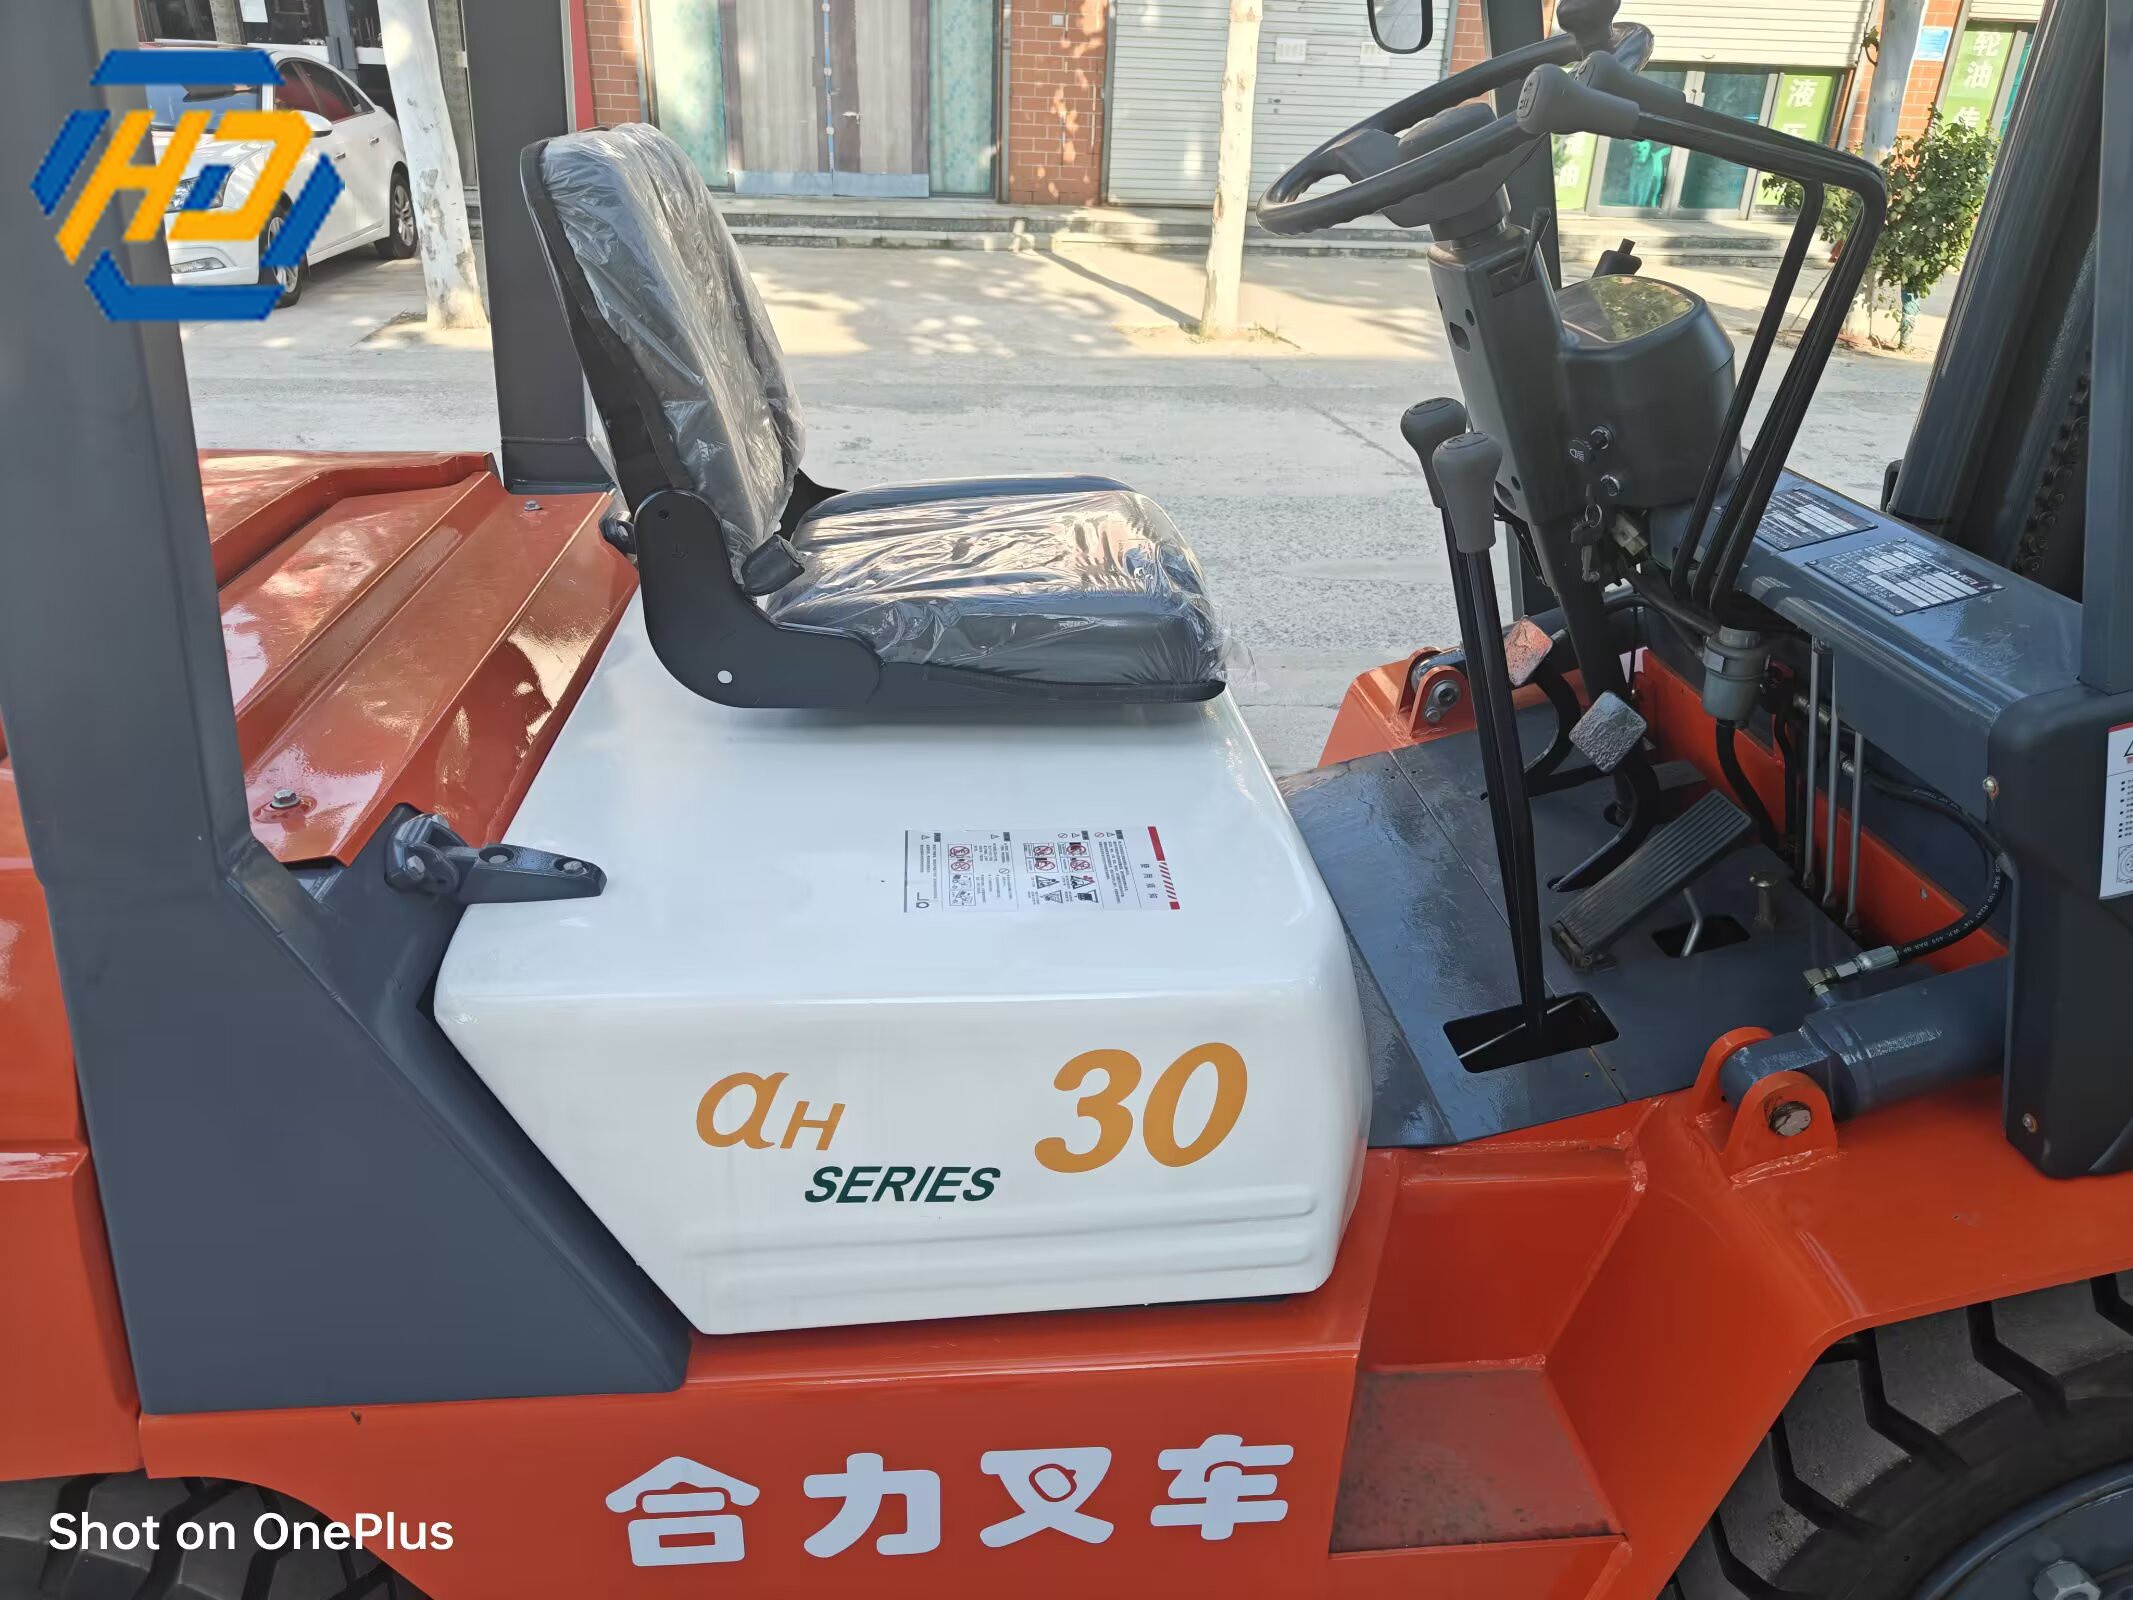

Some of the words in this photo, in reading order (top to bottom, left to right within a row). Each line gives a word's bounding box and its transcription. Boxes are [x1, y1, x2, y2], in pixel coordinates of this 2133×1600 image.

[1034, 1042, 1249, 1173] 30
[804, 1165, 1001, 1204] SERIES
[605, 1434, 1294, 1567] 合力叉车
